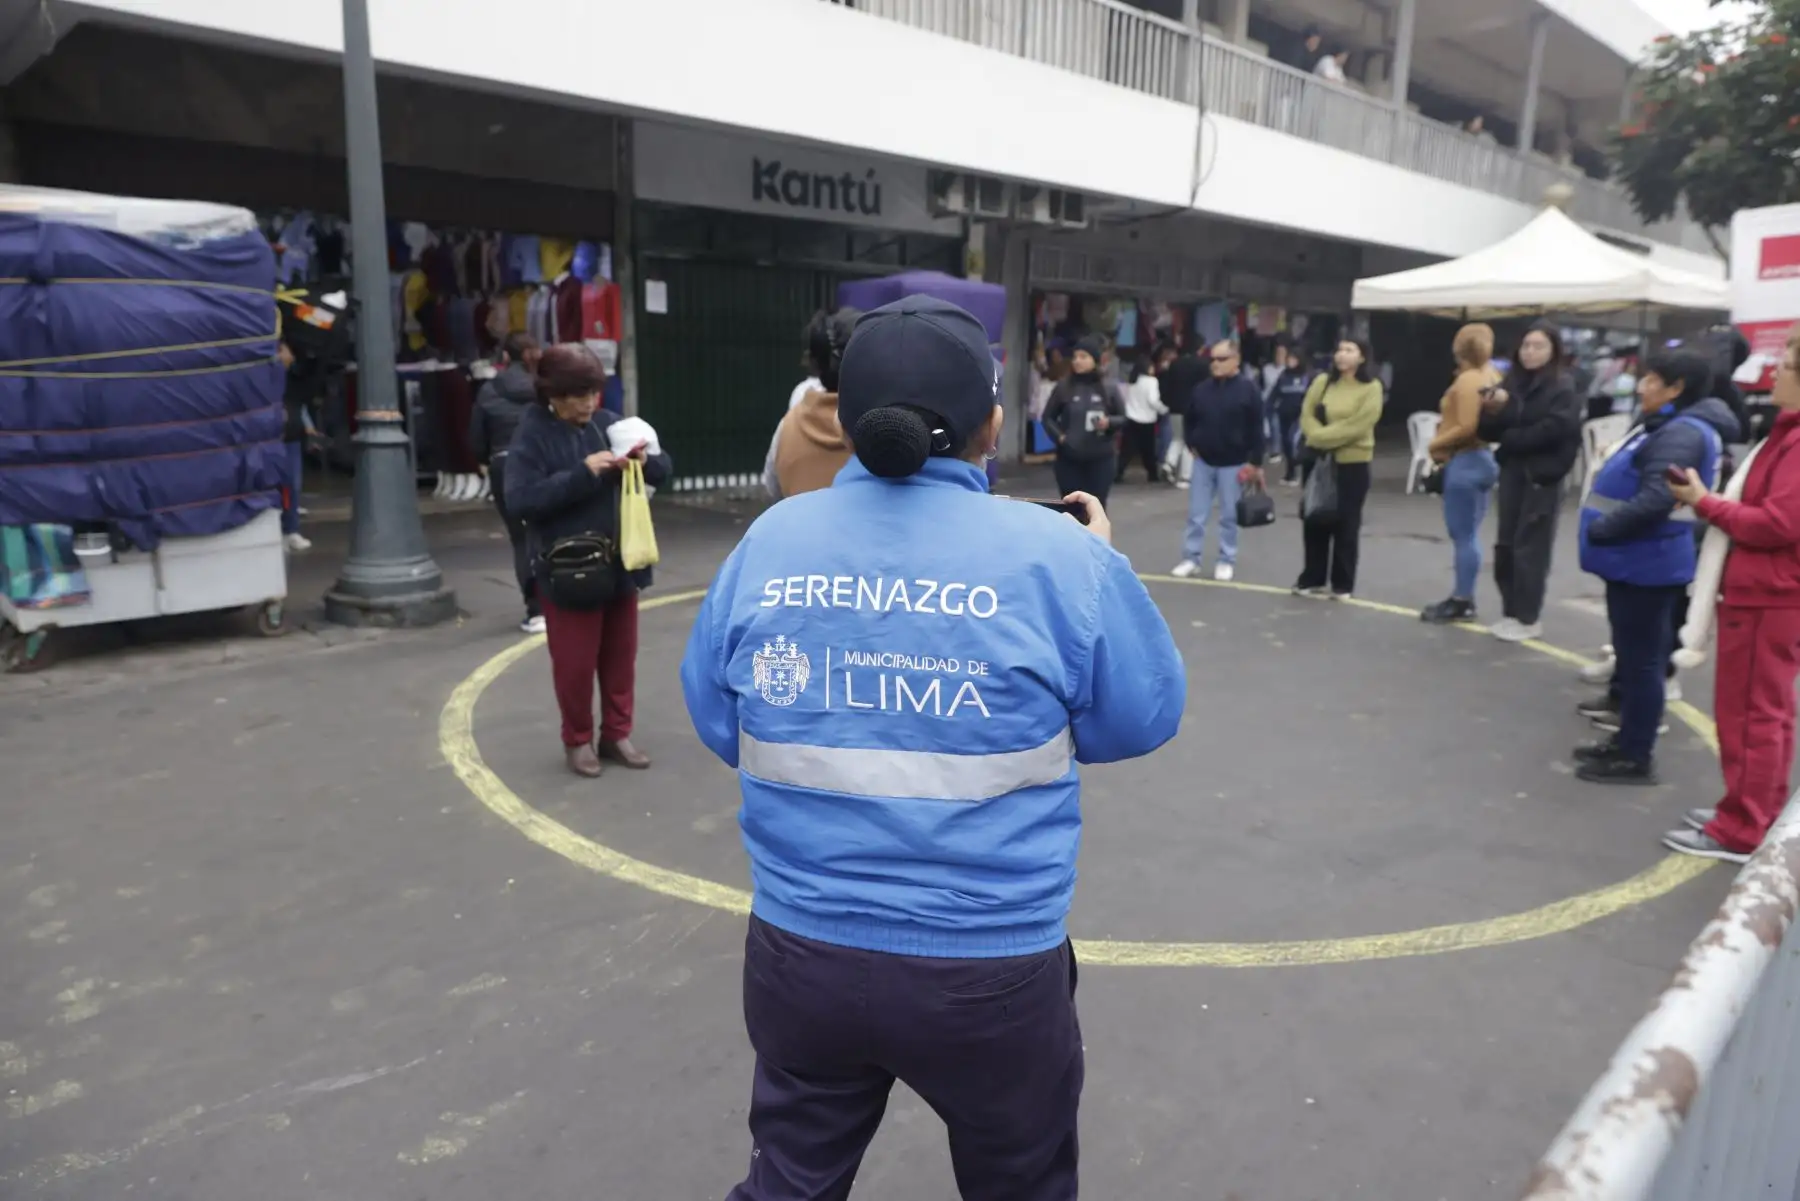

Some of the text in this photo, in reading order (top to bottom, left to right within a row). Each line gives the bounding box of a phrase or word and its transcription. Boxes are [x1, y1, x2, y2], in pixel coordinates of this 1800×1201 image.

[753, 157, 881, 215] Kantú
[760, 574, 998, 618] SERENAZGO
[844, 650, 989, 676] MUNICIPALIDAD DE
[845, 672, 991, 718] LIMA
